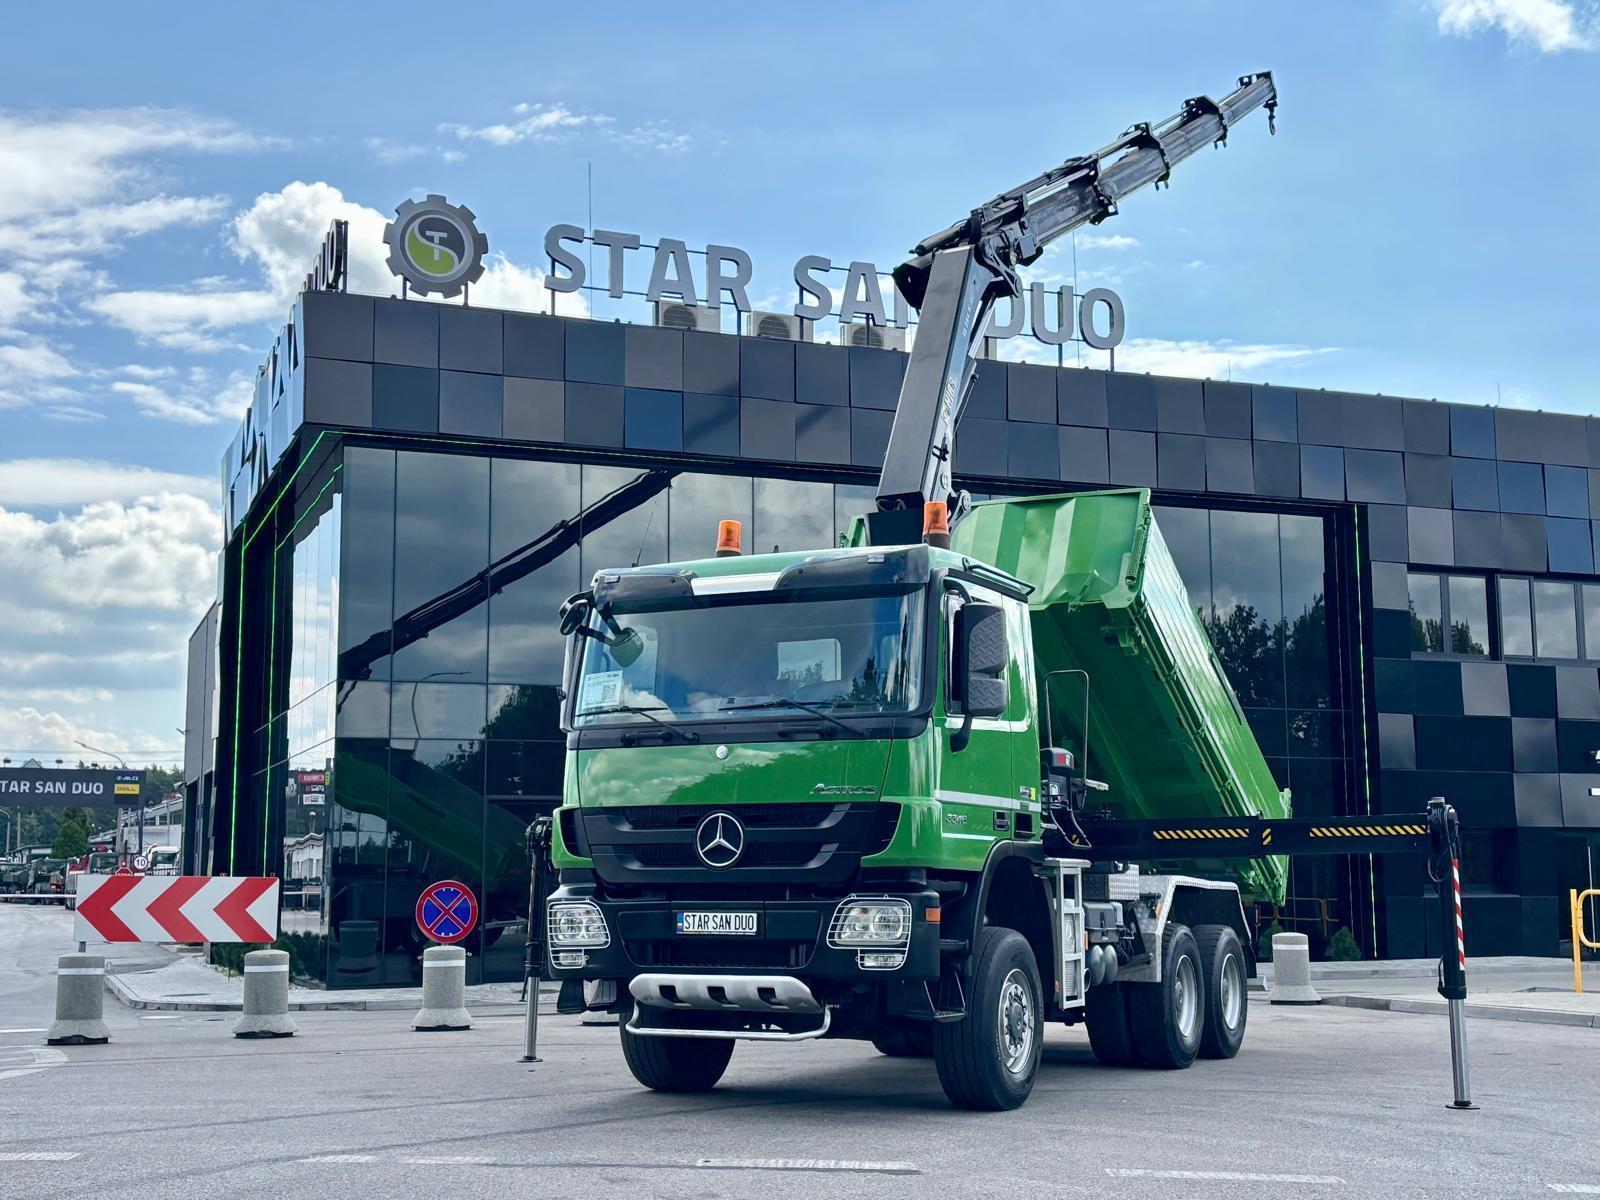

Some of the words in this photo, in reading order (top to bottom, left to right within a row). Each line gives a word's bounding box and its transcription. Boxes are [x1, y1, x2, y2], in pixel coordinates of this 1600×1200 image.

[544, 224, 752, 311] STAR
[35, 781, 66, 795] SAN
[72, 782, 104, 795] DUO
[136, 858, 146, 867] 10
[684, 914, 709, 930] STAR
[712, 914, 731, 930] SAN
[734, 914, 754, 931] DUO
